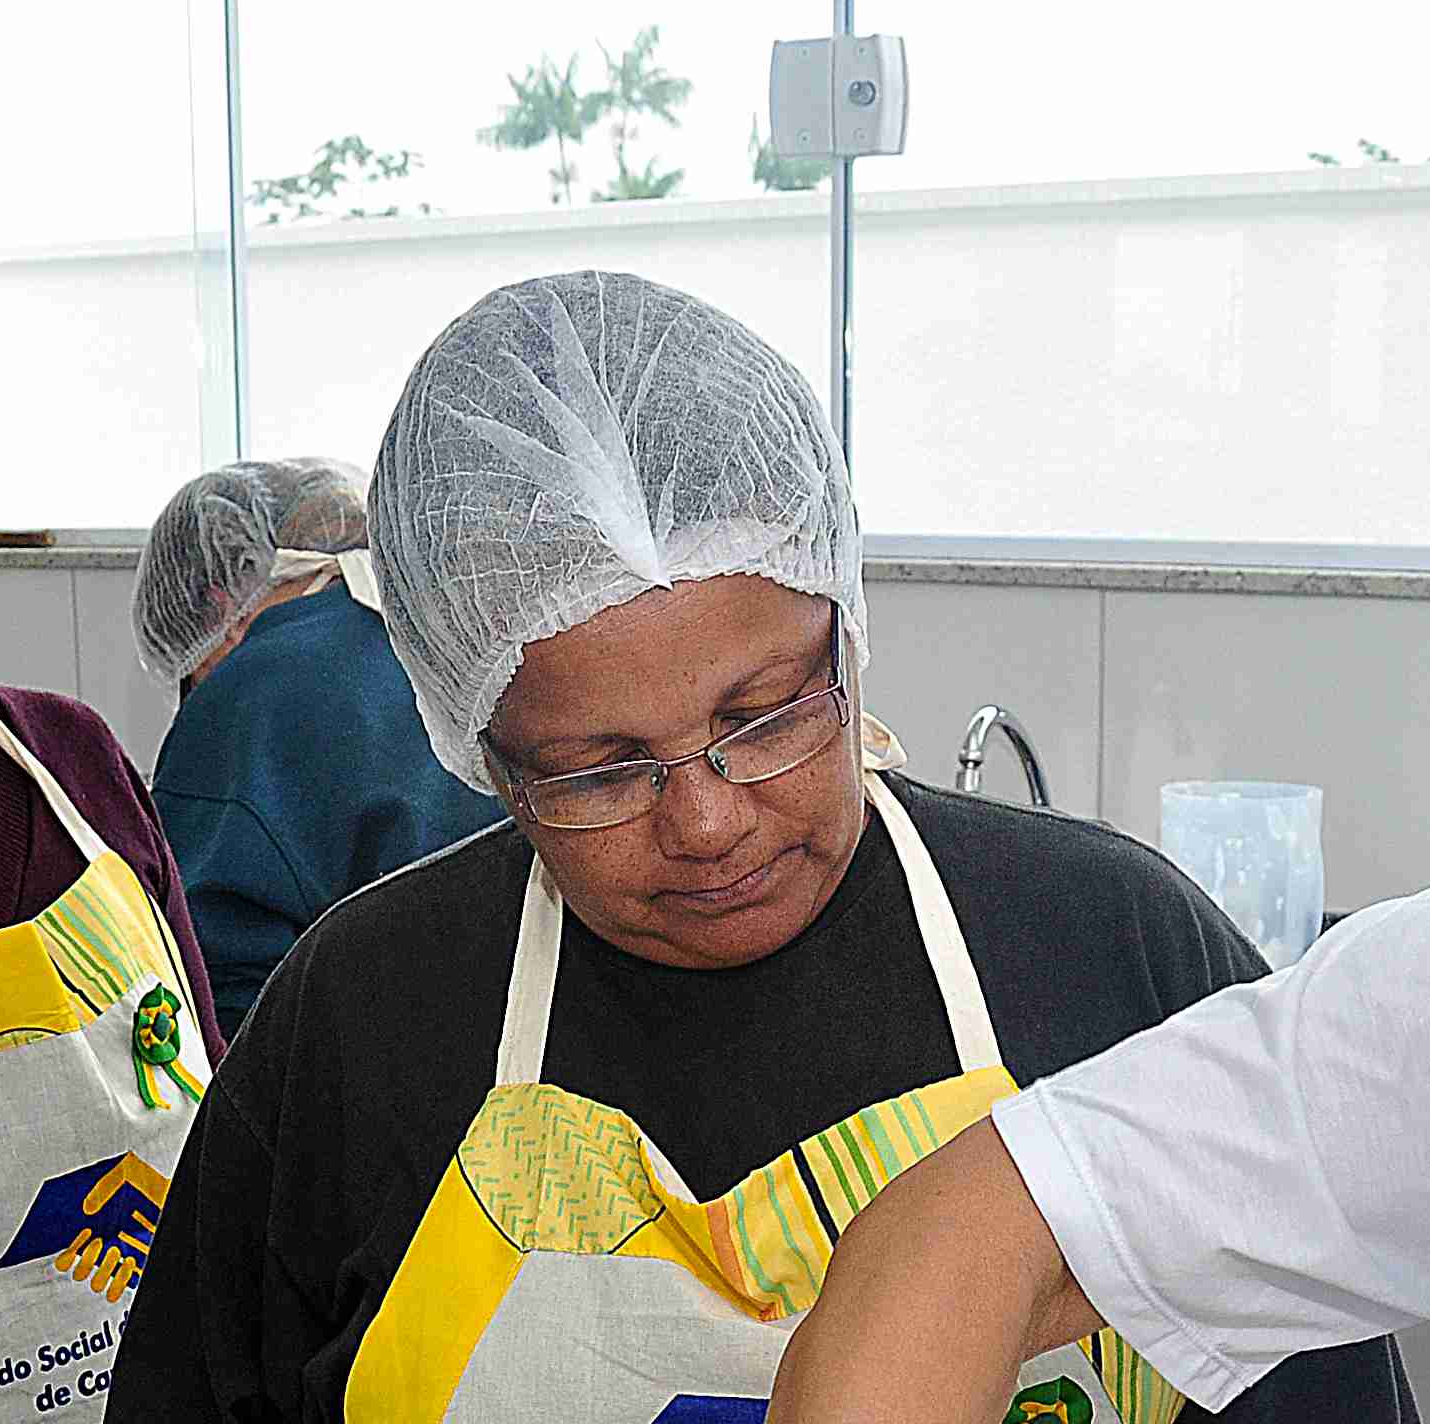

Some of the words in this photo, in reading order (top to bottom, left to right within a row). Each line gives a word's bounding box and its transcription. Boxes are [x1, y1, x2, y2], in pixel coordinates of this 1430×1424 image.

[38, 1320, 113, 1372] Social
[36, 1384, 71, 1412] de
[78, 1369, 114, 1397] Ca
